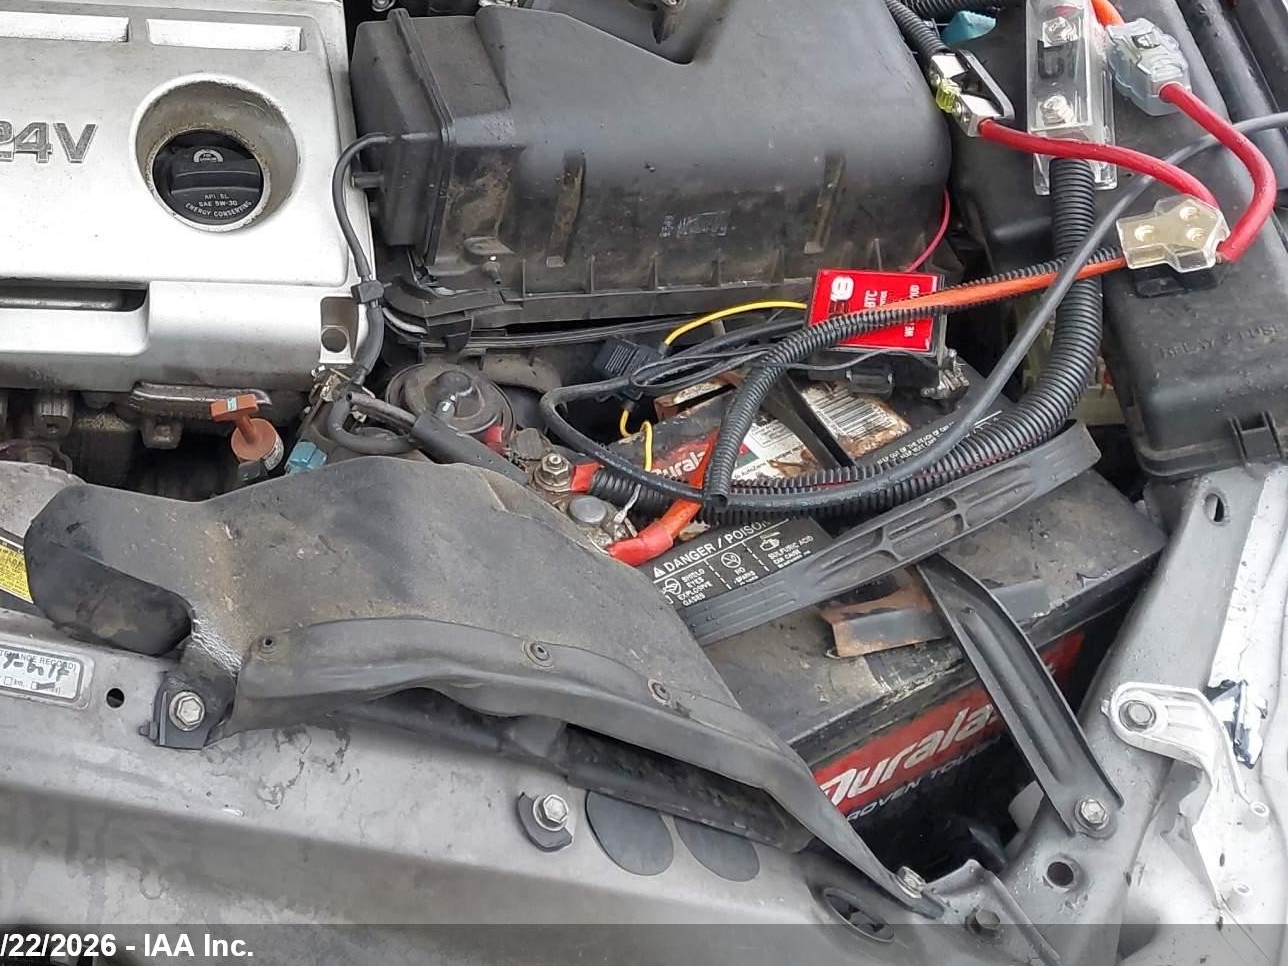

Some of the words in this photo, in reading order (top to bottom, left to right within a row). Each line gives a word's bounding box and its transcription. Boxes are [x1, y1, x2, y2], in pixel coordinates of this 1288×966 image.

[186, 203, 211, 215] ENERGY
[214, 201, 252, 216] CONSERVING
[799, 536, 814, 545] ACID
[664, 542, 717, 572] DANGER
[682, 568, 705, 584] SHIELD
[686, 577, 704, 589] EYES
[678, 580, 713, 601] EXPLOSIVE
[683, 594, 706, 606] GASES
[847, 779, 921, 822] ROVEN
